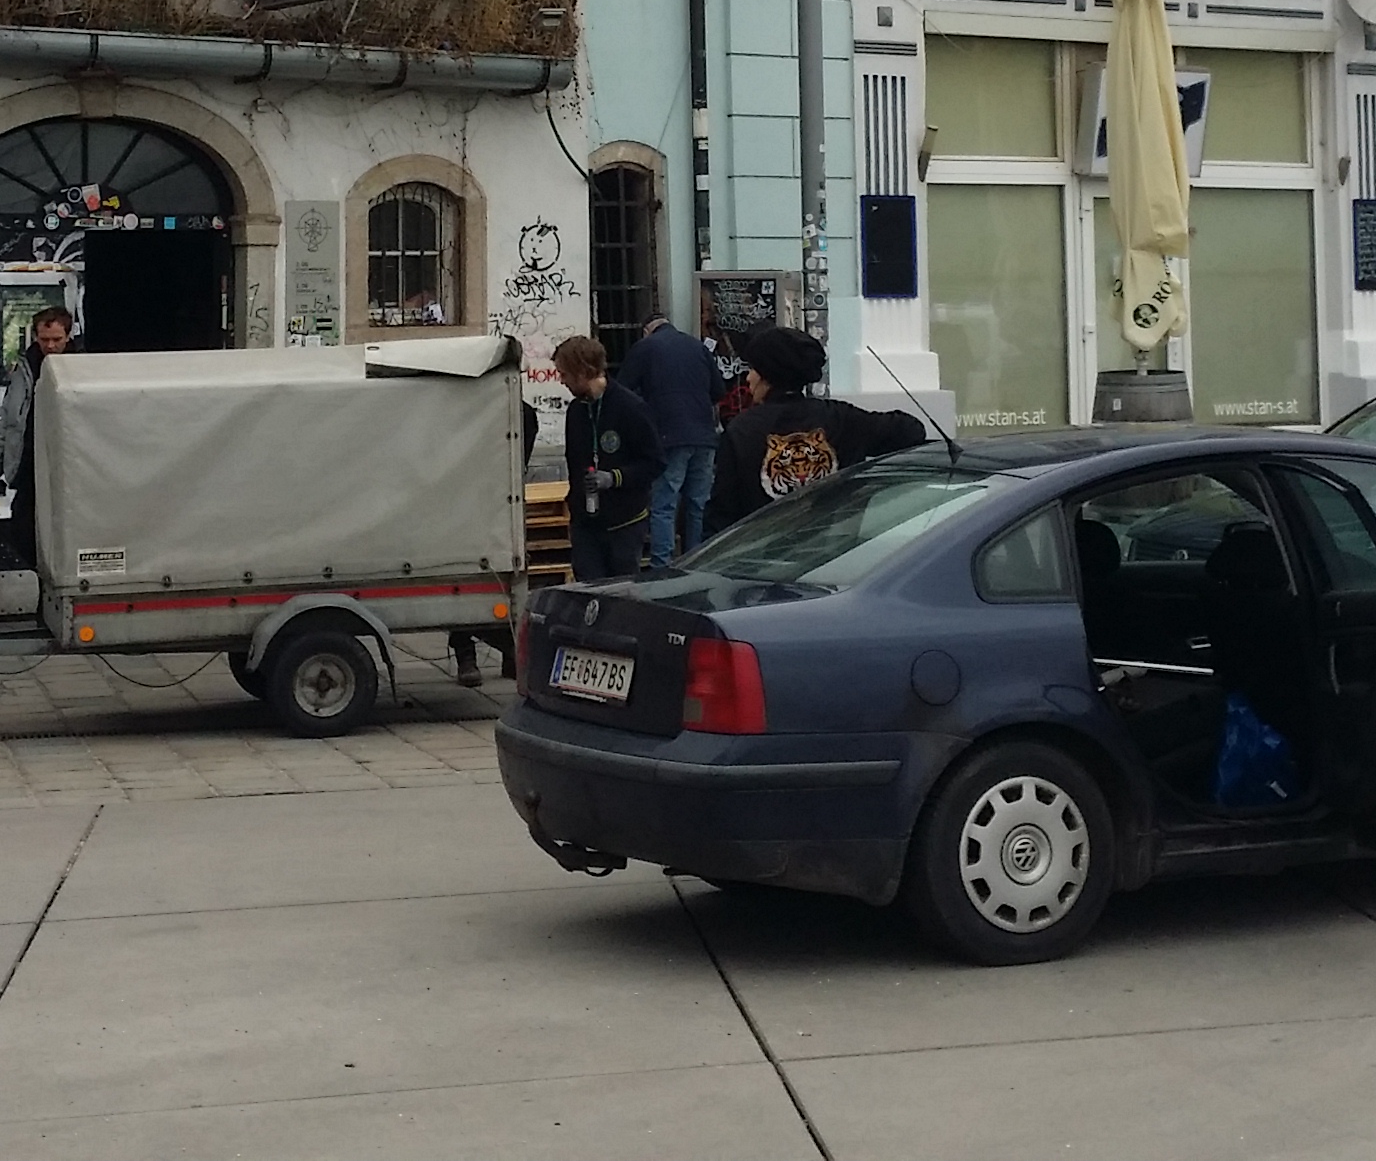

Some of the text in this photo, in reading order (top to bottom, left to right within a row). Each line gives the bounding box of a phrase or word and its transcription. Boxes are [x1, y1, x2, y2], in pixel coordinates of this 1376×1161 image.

[1214, 399, 1299, 417] www.stan-s.at
[666, 632, 687, 646] TDI
[561, 654, 579, 681] EF
